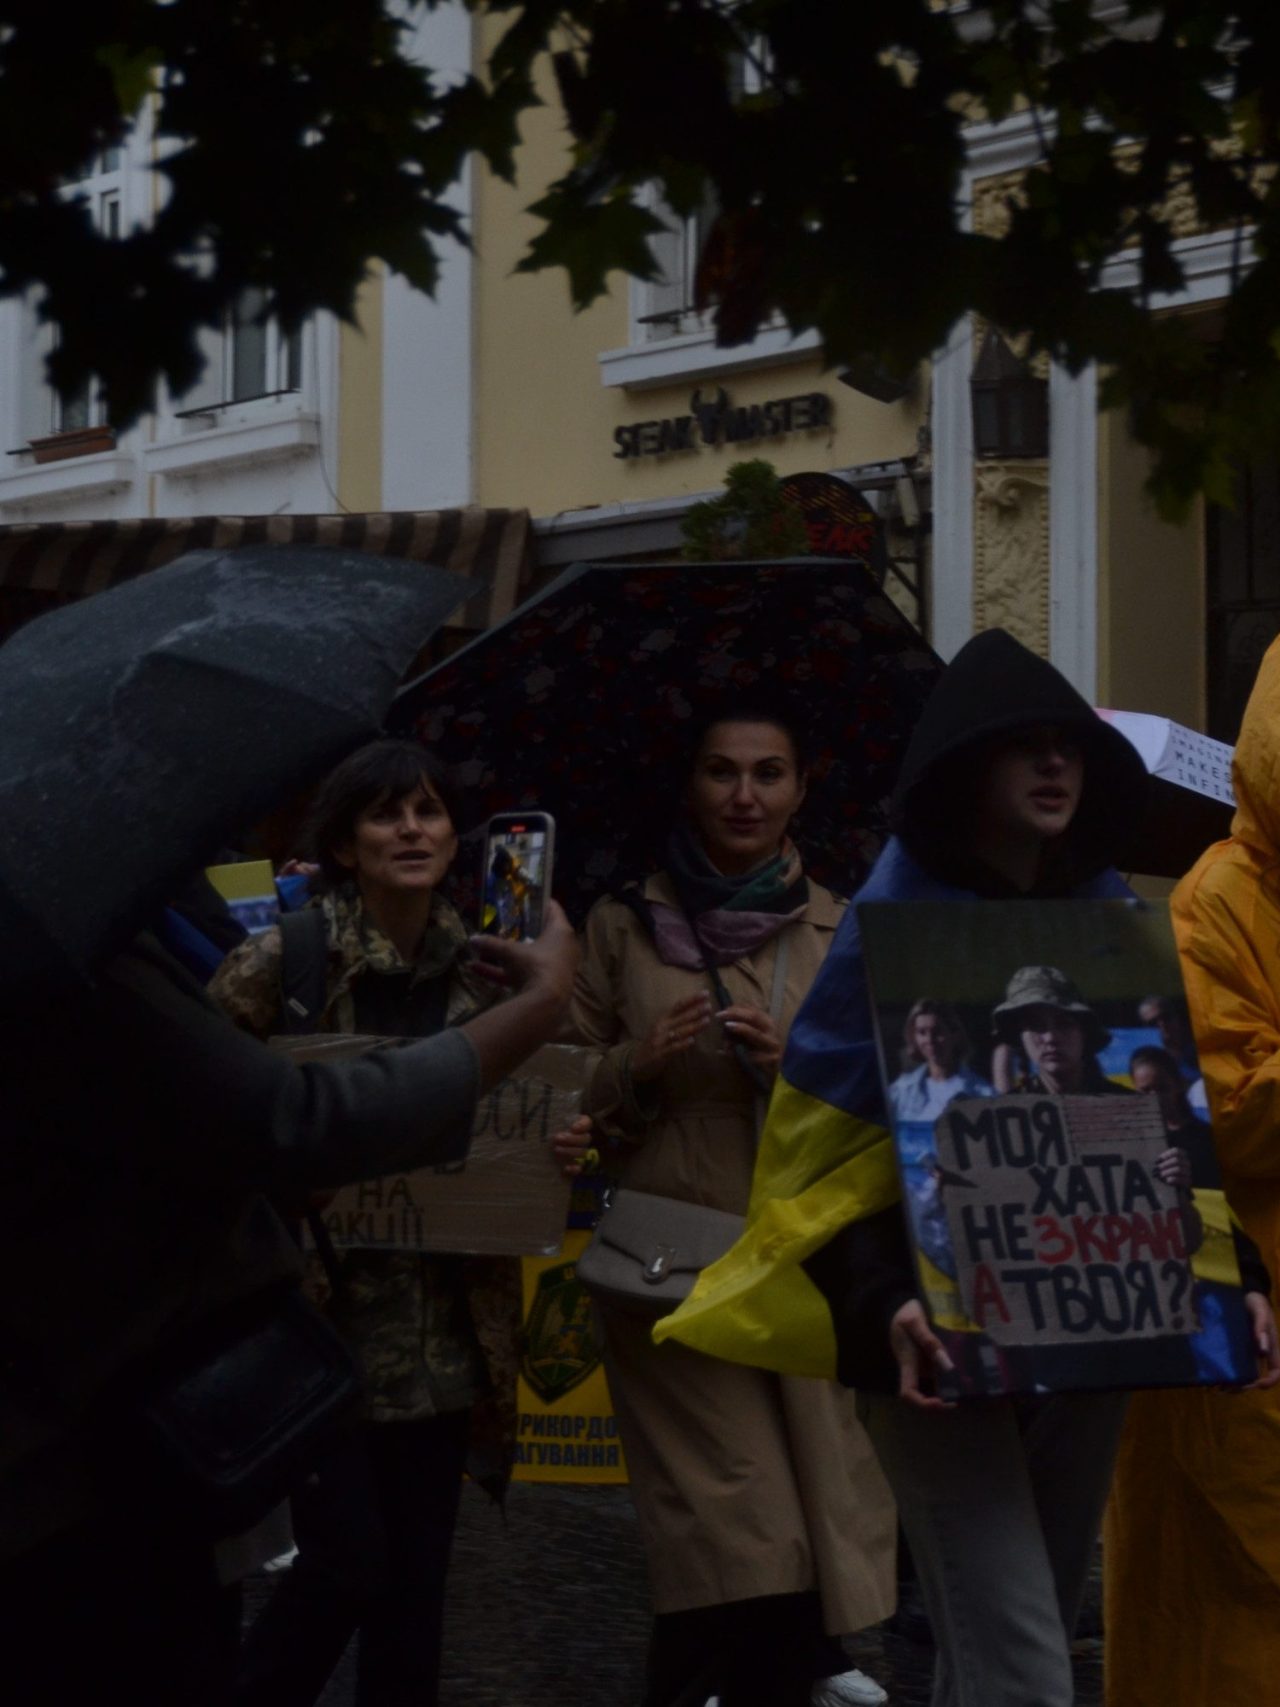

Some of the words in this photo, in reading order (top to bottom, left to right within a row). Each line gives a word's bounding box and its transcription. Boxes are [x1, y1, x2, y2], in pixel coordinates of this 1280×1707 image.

[614, 416, 693, 459] STEAK
[724, 392, 830, 443] MASTER
[1176, 750, 1232, 784] MAKES
[948, 1100, 1069, 1170] МОЯ
[358, 1177, 413, 1210] НА
[1028, 1154, 1162, 1216] ХАТА
[961, 1202, 1035, 1262] НЕ
[1002, 1259, 1190, 1334] ТВОЯ?
